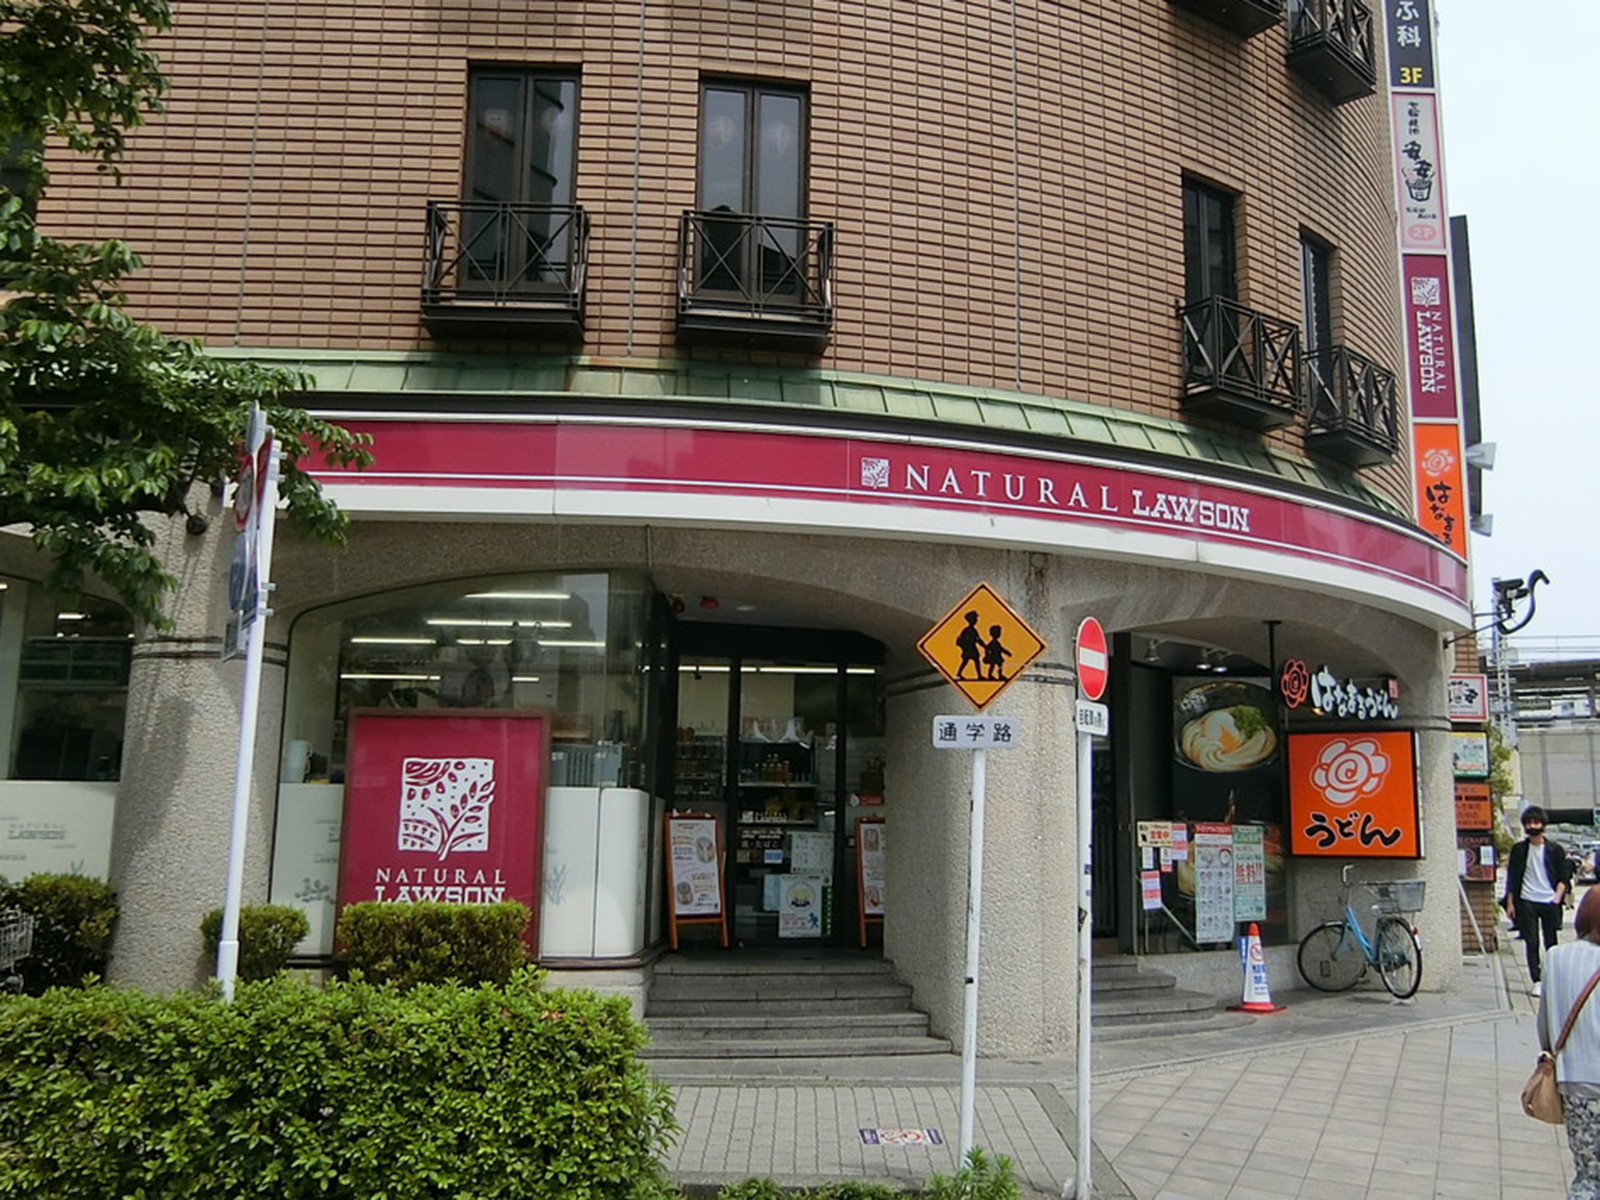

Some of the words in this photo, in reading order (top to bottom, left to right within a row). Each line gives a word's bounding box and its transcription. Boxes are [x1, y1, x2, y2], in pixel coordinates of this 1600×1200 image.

[1396, 1, 1421, 47] ふ科
[1400, 67, 1422, 84] 3F
[1417, 311, 1435, 393] LAWSON
[1431, 311, 1447, 393] NATURAL
[904, 464, 1119, 512] NATURAL
[1132, 489, 1250, 533] LAWSON
[1311, 665, 1399, 720] はなまるうどん
[938, 723, 1012, 742] 通学路
[1305, 812, 1402, 848] うどん
[375, 868, 506, 884] NATURAL
[375, 886, 506, 905] LAWSON
